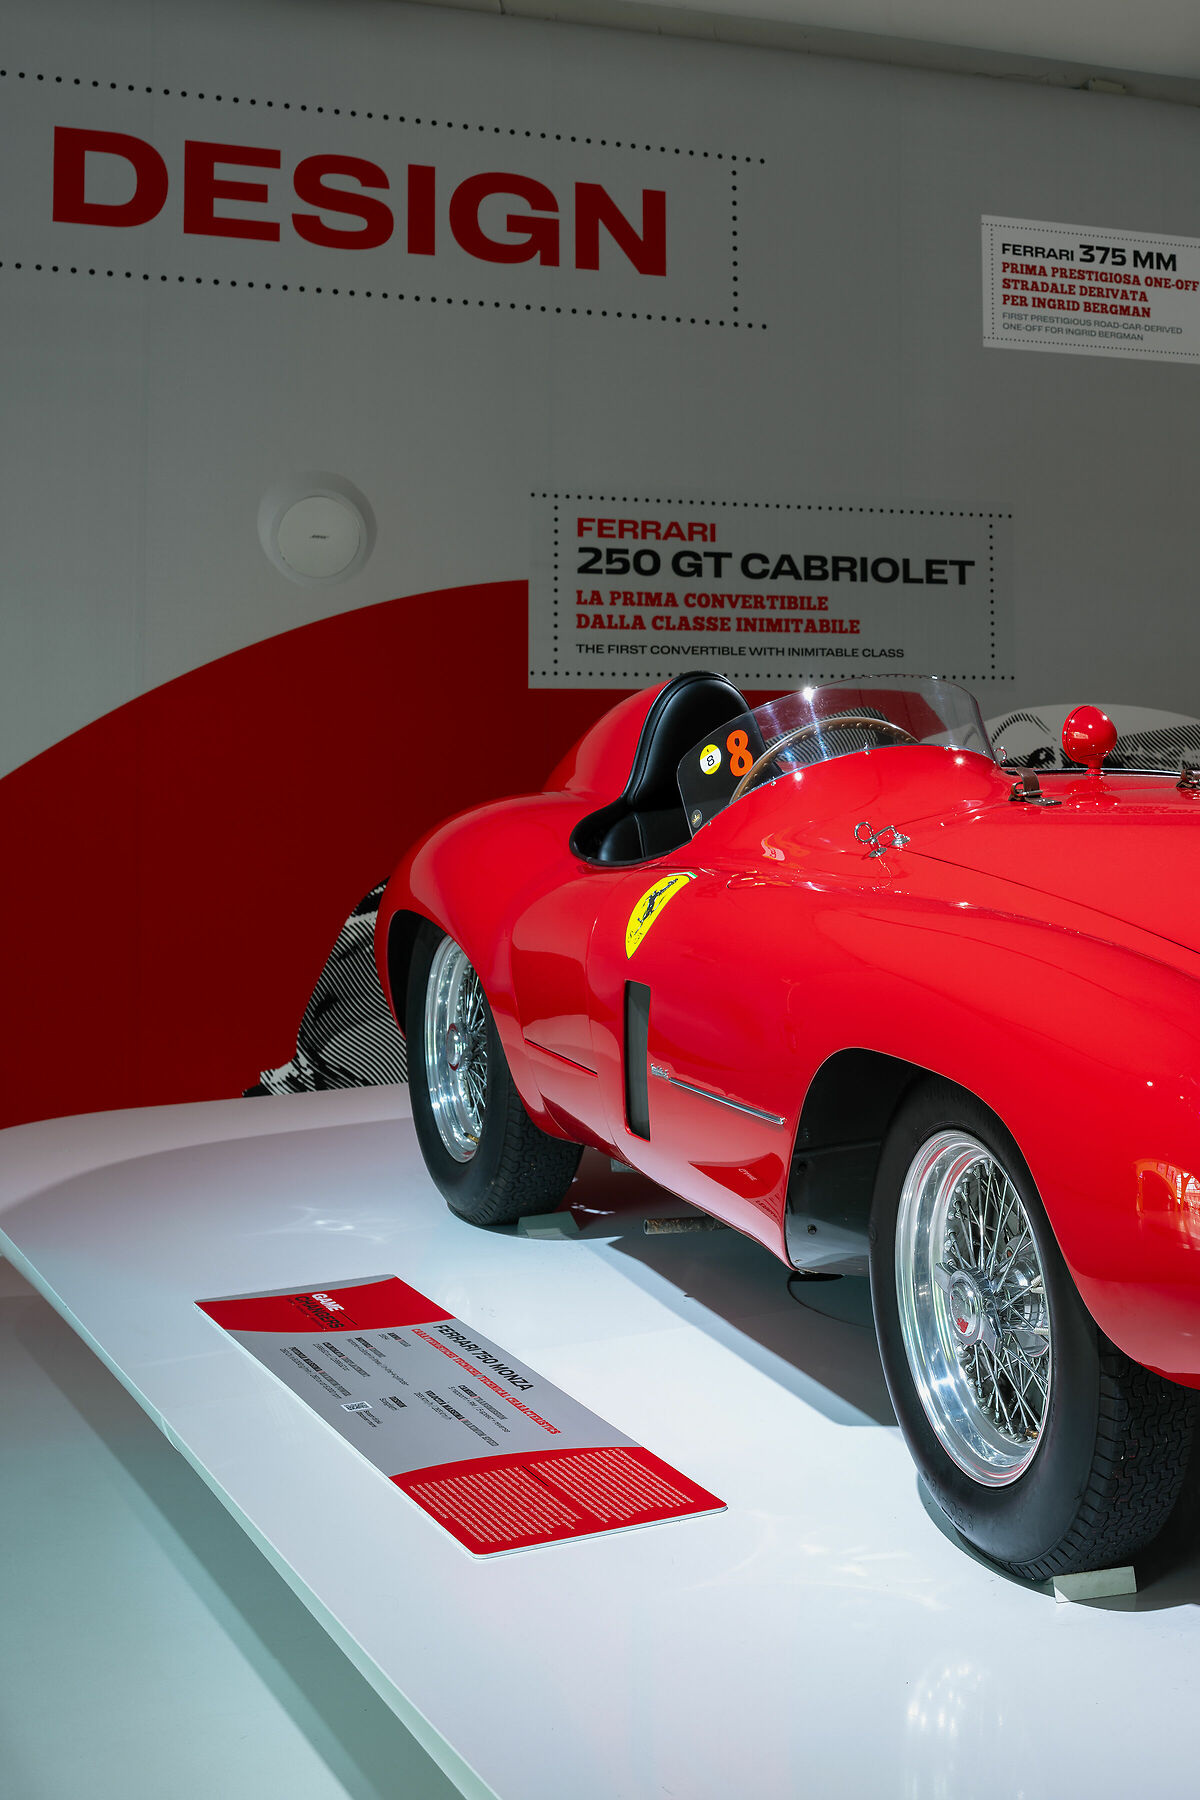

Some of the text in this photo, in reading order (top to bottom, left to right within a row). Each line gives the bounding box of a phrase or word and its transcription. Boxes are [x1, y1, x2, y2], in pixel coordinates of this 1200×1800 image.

[52, 126, 667, 277] DESIGN
[1002, 243, 1177, 271] FERRARI 375 MM
[1001, 262, 1200, 291] PRIMA PRESTIGIOSA ONE-OFF
[1002, 278, 1148, 302] STRADALE DERIVATA
[1002, 294, 1151, 318] PER INGRID BERGMAN
[1002, 312, 1183, 334] FIRST PRESTIGIOUS ROAD-CAR-DERIVED
[1002, 323, 1144, 341] ONE-OFF FOR INGRID BERGMAN
[576, 517, 716, 542] FERRARI
[576, 546, 975, 585] 250 GT CABRIOLET
[576, 590, 829, 612] LA PRIMA CONVERTIBILE
[576, 613, 861, 634] DALLA CLASSE INIMITABILE
[576, 643, 905, 659] THE FIRST CONVERTIBLE WITH INIMITABLE CLASS
[706, 754, 715, 767] 8
[726, 730, 754, 777] 8
[295, 1296, 345, 1329] CHANGERS
[312, 1293, 345, 1312] GAME
[433, 1324, 482, 1352] FERRARI
[472, 1349, 499, 1365] 750
[490, 1362, 534, 1392] MONZA
